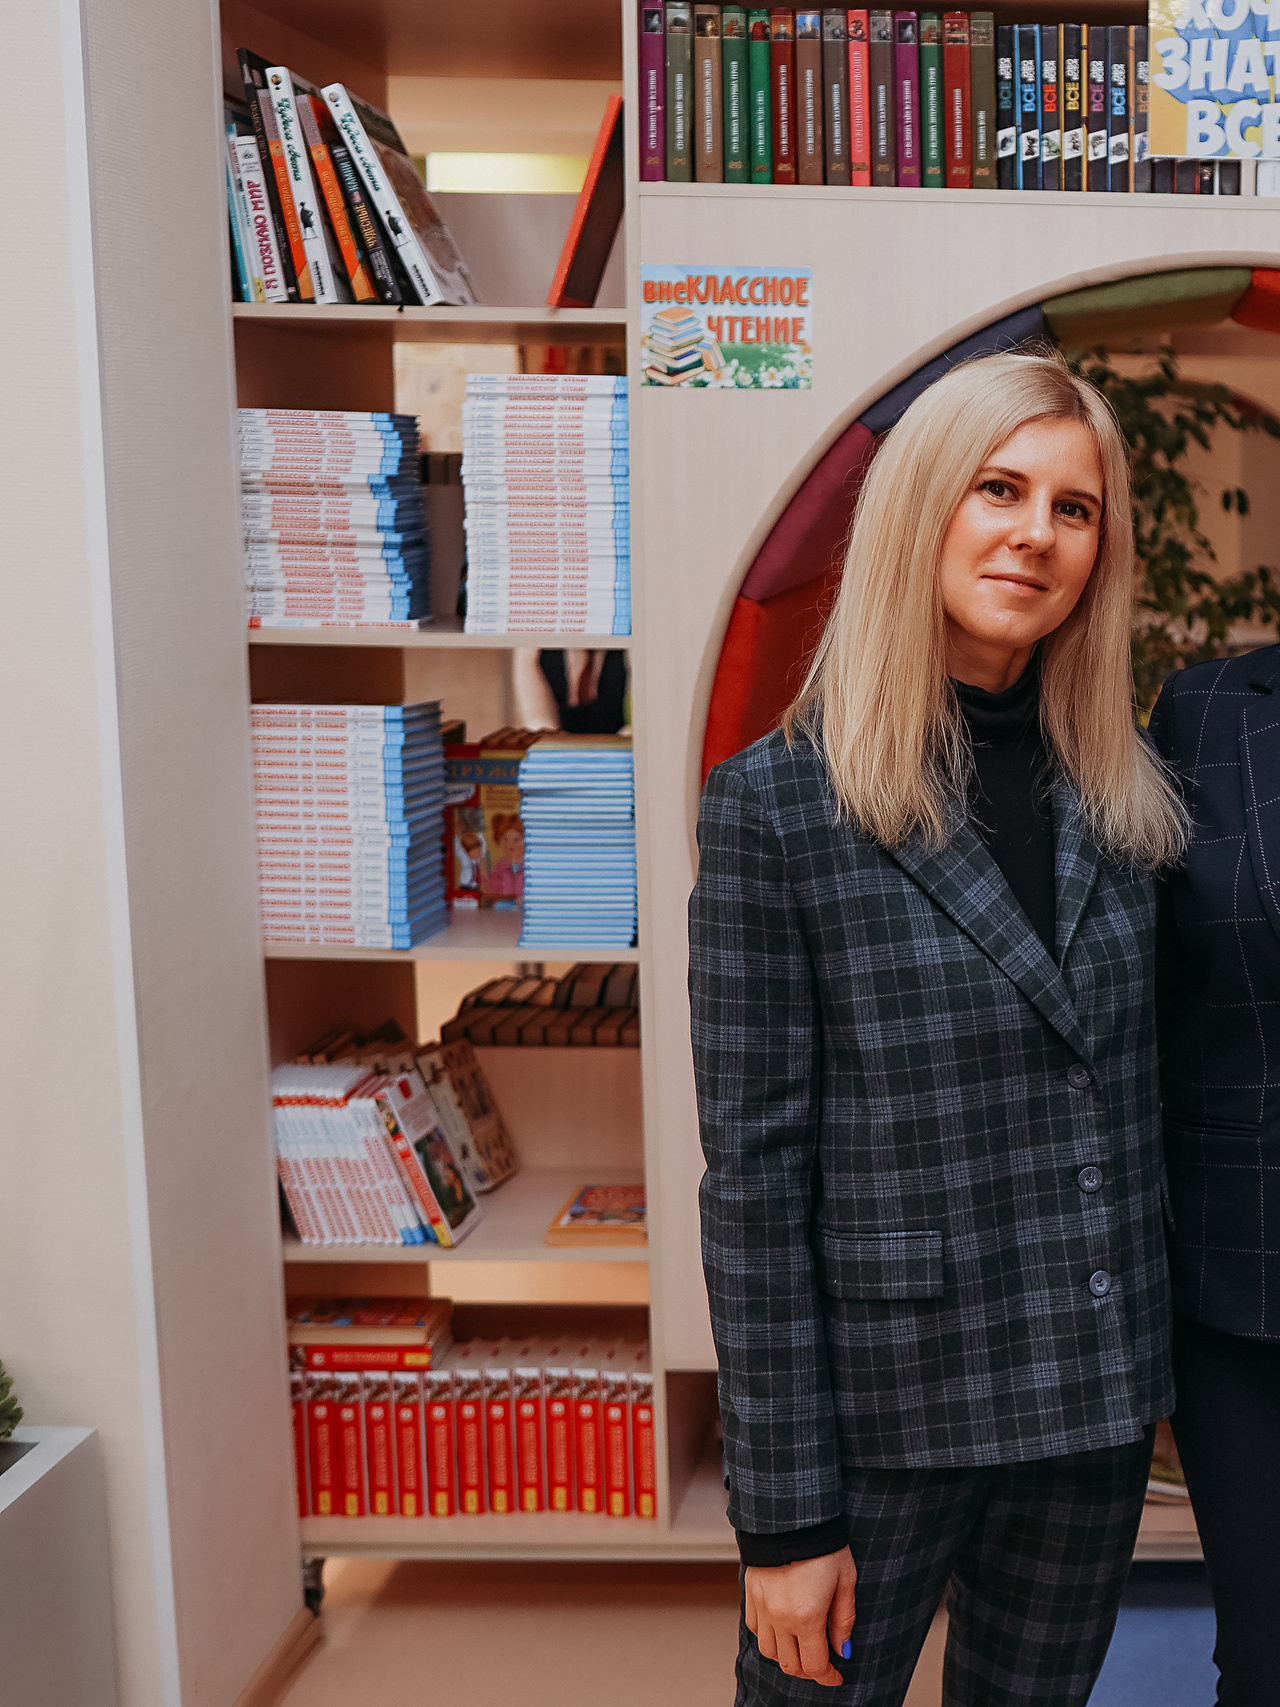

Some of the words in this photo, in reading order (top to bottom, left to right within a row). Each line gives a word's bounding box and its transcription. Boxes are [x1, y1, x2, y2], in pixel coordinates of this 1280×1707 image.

[1000, 82, 1011, 108] ВСЕ
[1023, 84, 1035, 111] ВСЕ
[1043, 85, 1056, 112] ВСЕ
[1066, 83, 1079, 110] ВСЕ
[1091, 85, 1104, 111] ВСЕ
[1112, 88, 1125, 115] ВСЕ
[855, 105, 863, 136] ВЕЛИКИХ
[277, 97, 294, 142] Чудеса
[287, 144, 301, 181] света
[340, 112, 363, 154] Чудеса
[360, 157, 381, 192] света
[340, 162, 358, 192] КАМНИ
[247, 180, 266, 212] МИР
[277, 166, 285, 181] ВСЕ
[281, 183, 293, 218] ЧУДЕСА
[288, 218, 298, 243] СВЕТА
[354, 203, 377, 248] ЧУДЕСНЫЕ
[253, 215, 276, 275] ПОЗНАЮ
[265, 277, 279, 290] Я
[643, 275, 809, 305] внеКЛАССНОЕ
[707, 316, 805, 344] ЧТЕНИЕ
